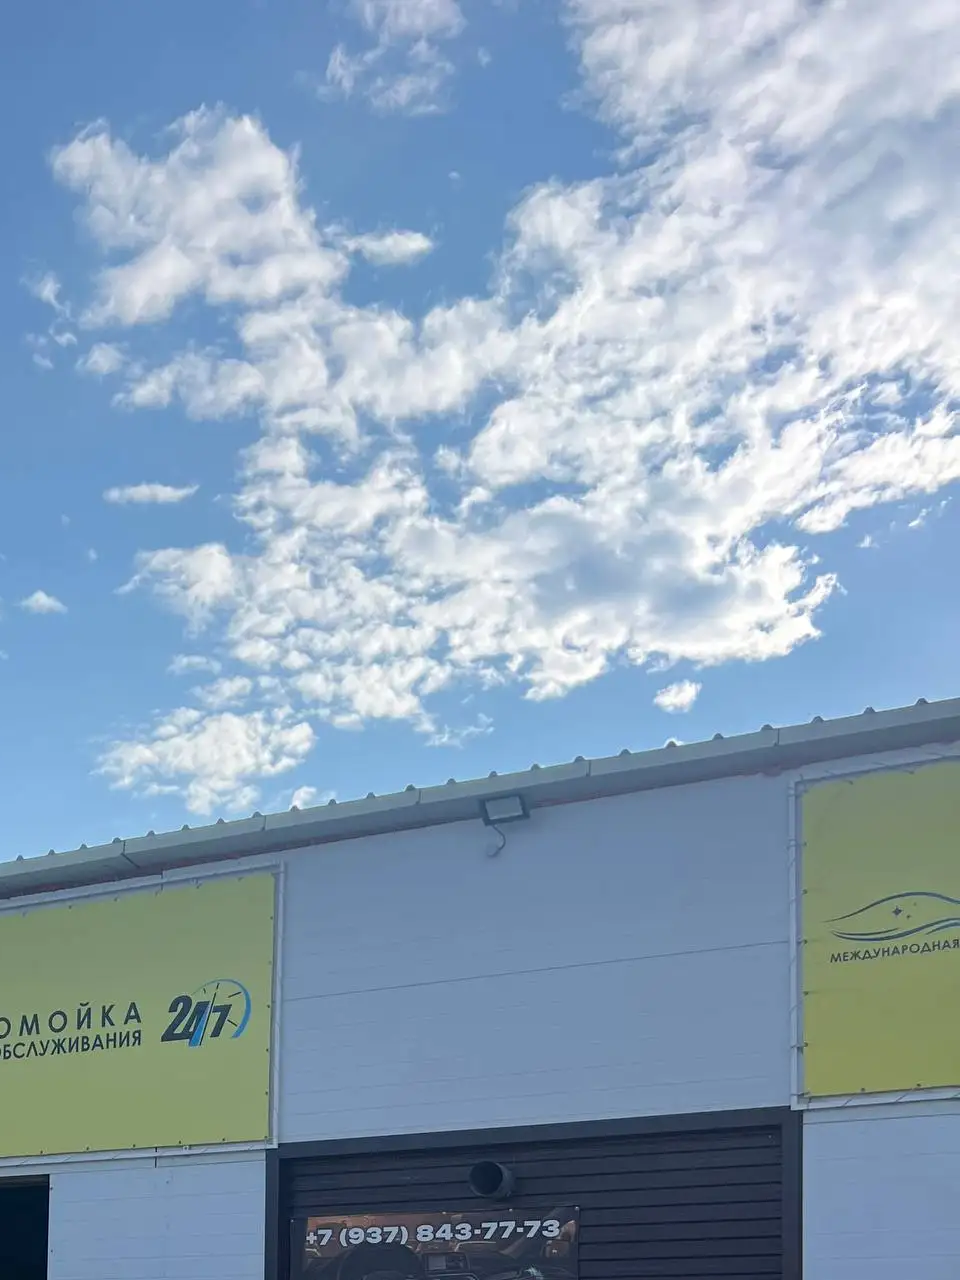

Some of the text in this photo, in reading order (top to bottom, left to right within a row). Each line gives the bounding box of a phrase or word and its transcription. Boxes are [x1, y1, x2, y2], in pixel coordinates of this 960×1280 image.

[829, 938, 960, 963] МЕЖДУНАРОДНАЯ
[160, 990, 232, 1047] 24/7
[305, 1219, 561, 1248] +7 (937) 843-77-73
